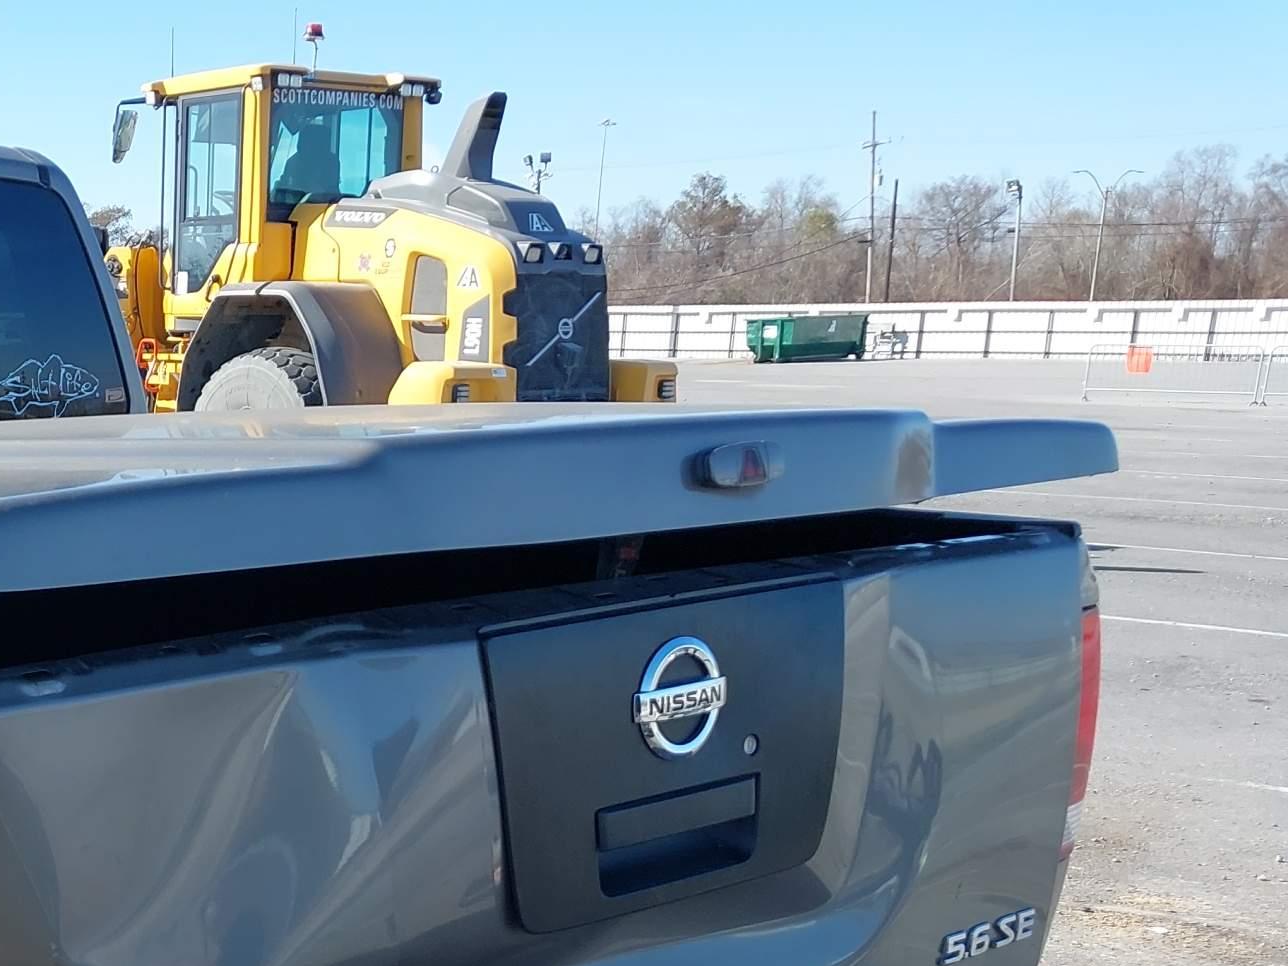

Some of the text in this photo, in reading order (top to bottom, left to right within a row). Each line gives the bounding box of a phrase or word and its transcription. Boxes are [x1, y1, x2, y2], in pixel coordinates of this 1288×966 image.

[334, 210, 386, 223] VOLVO
[464, 317, 483, 355] L90H
[648, 683, 722, 716] NISSAN
